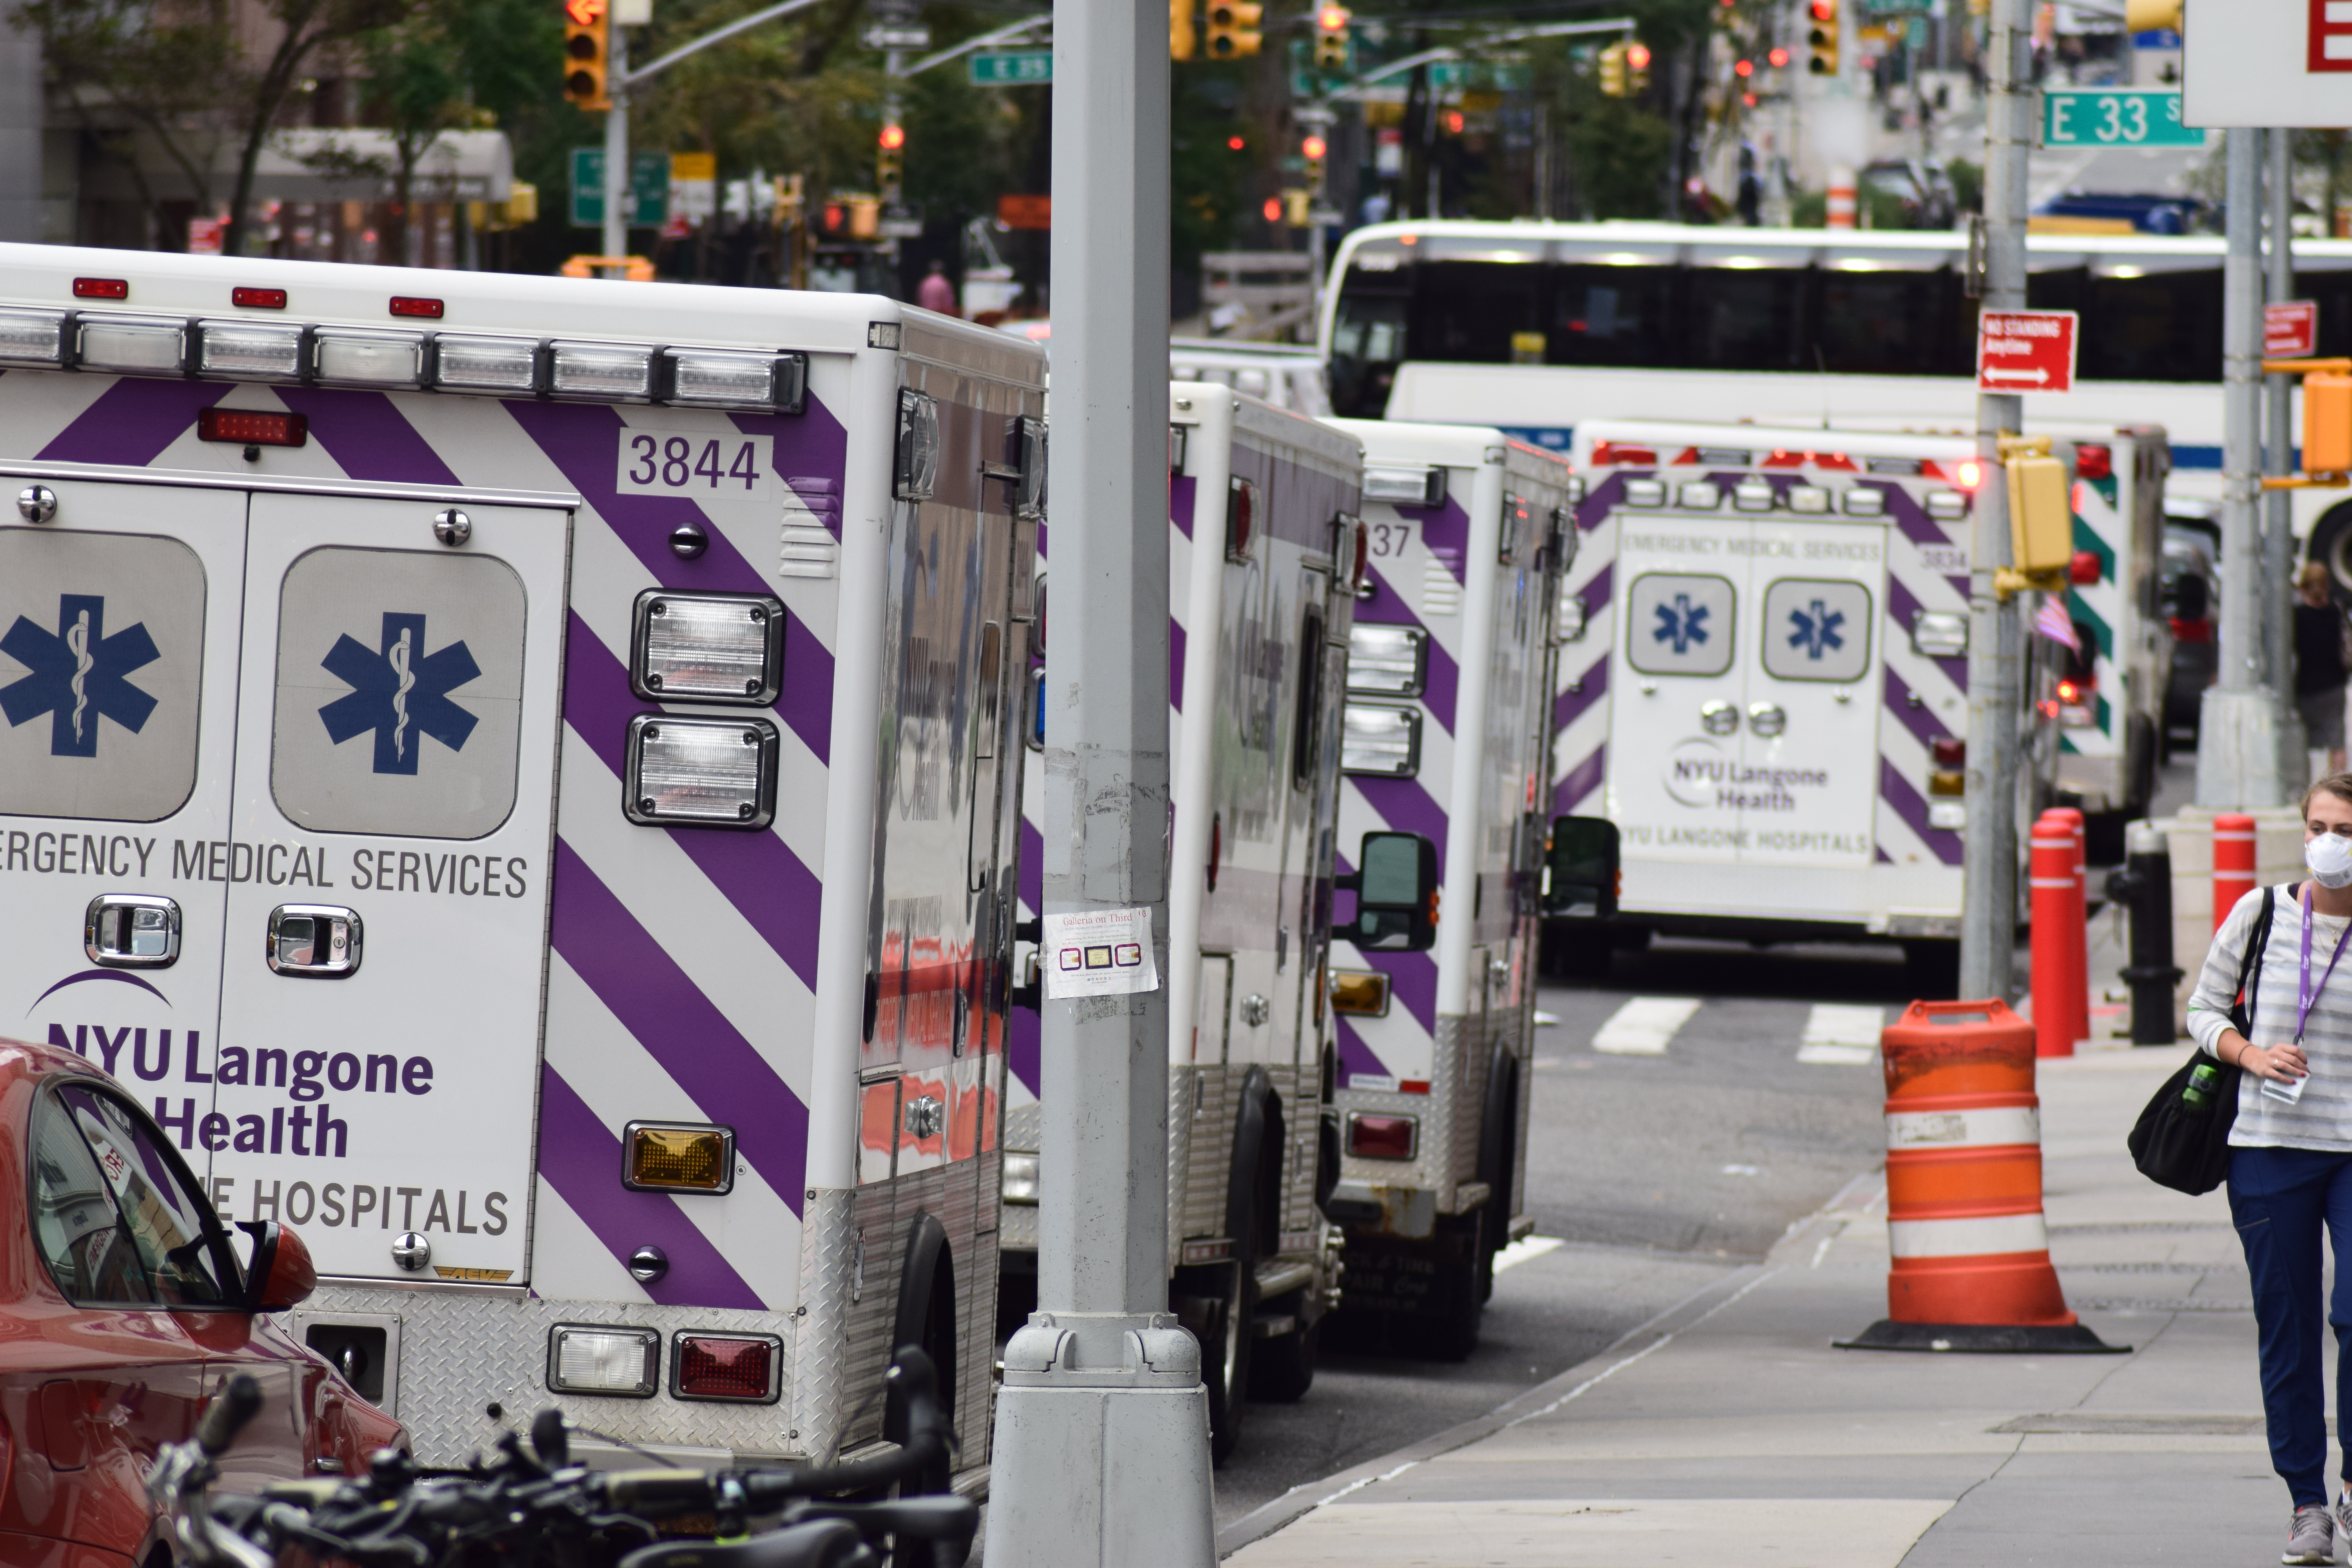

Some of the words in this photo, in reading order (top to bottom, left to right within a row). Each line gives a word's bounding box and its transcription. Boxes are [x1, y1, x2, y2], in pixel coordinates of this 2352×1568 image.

[2052, 97, 2076, 141] E
[2095, 97, 2147, 142] 33
[2166, 98, 2180, 122] S
[1985, 319, 2002, 336] NO
[2004, 319, 2061, 339] STANDING
[629, 434, 760, 491] 3844
[1624, 533, 1722, 555] EMERGENCY
[1726, 537, 1797, 559] MEDICAL
[1804, 541, 1880, 561] SERVICES
[1674, 759, 1724, 782] NYU
[1729, 761, 1828, 790] Langone
[1717, 788, 1795, 811] Health
[1657, 827, 1750, 849] LANGONE
[1757, 830, 1867, 853] HOSPITALS
[0, 830, 156, 877] RGENCY
[172, 839, 333, 887] MEDICAL
[352, 849, 527, 898] SERVICES
[1063, 916, 1093, 926] Galleria
[1109, 913, 1132, 922] Third
[48, 1023, 171, 1081] NYU
[185, 1030, 434, 1102] Langone
[154, 1096, 348, 1158] Health
[253, 1179, 508, 1237] HOSPITALS
